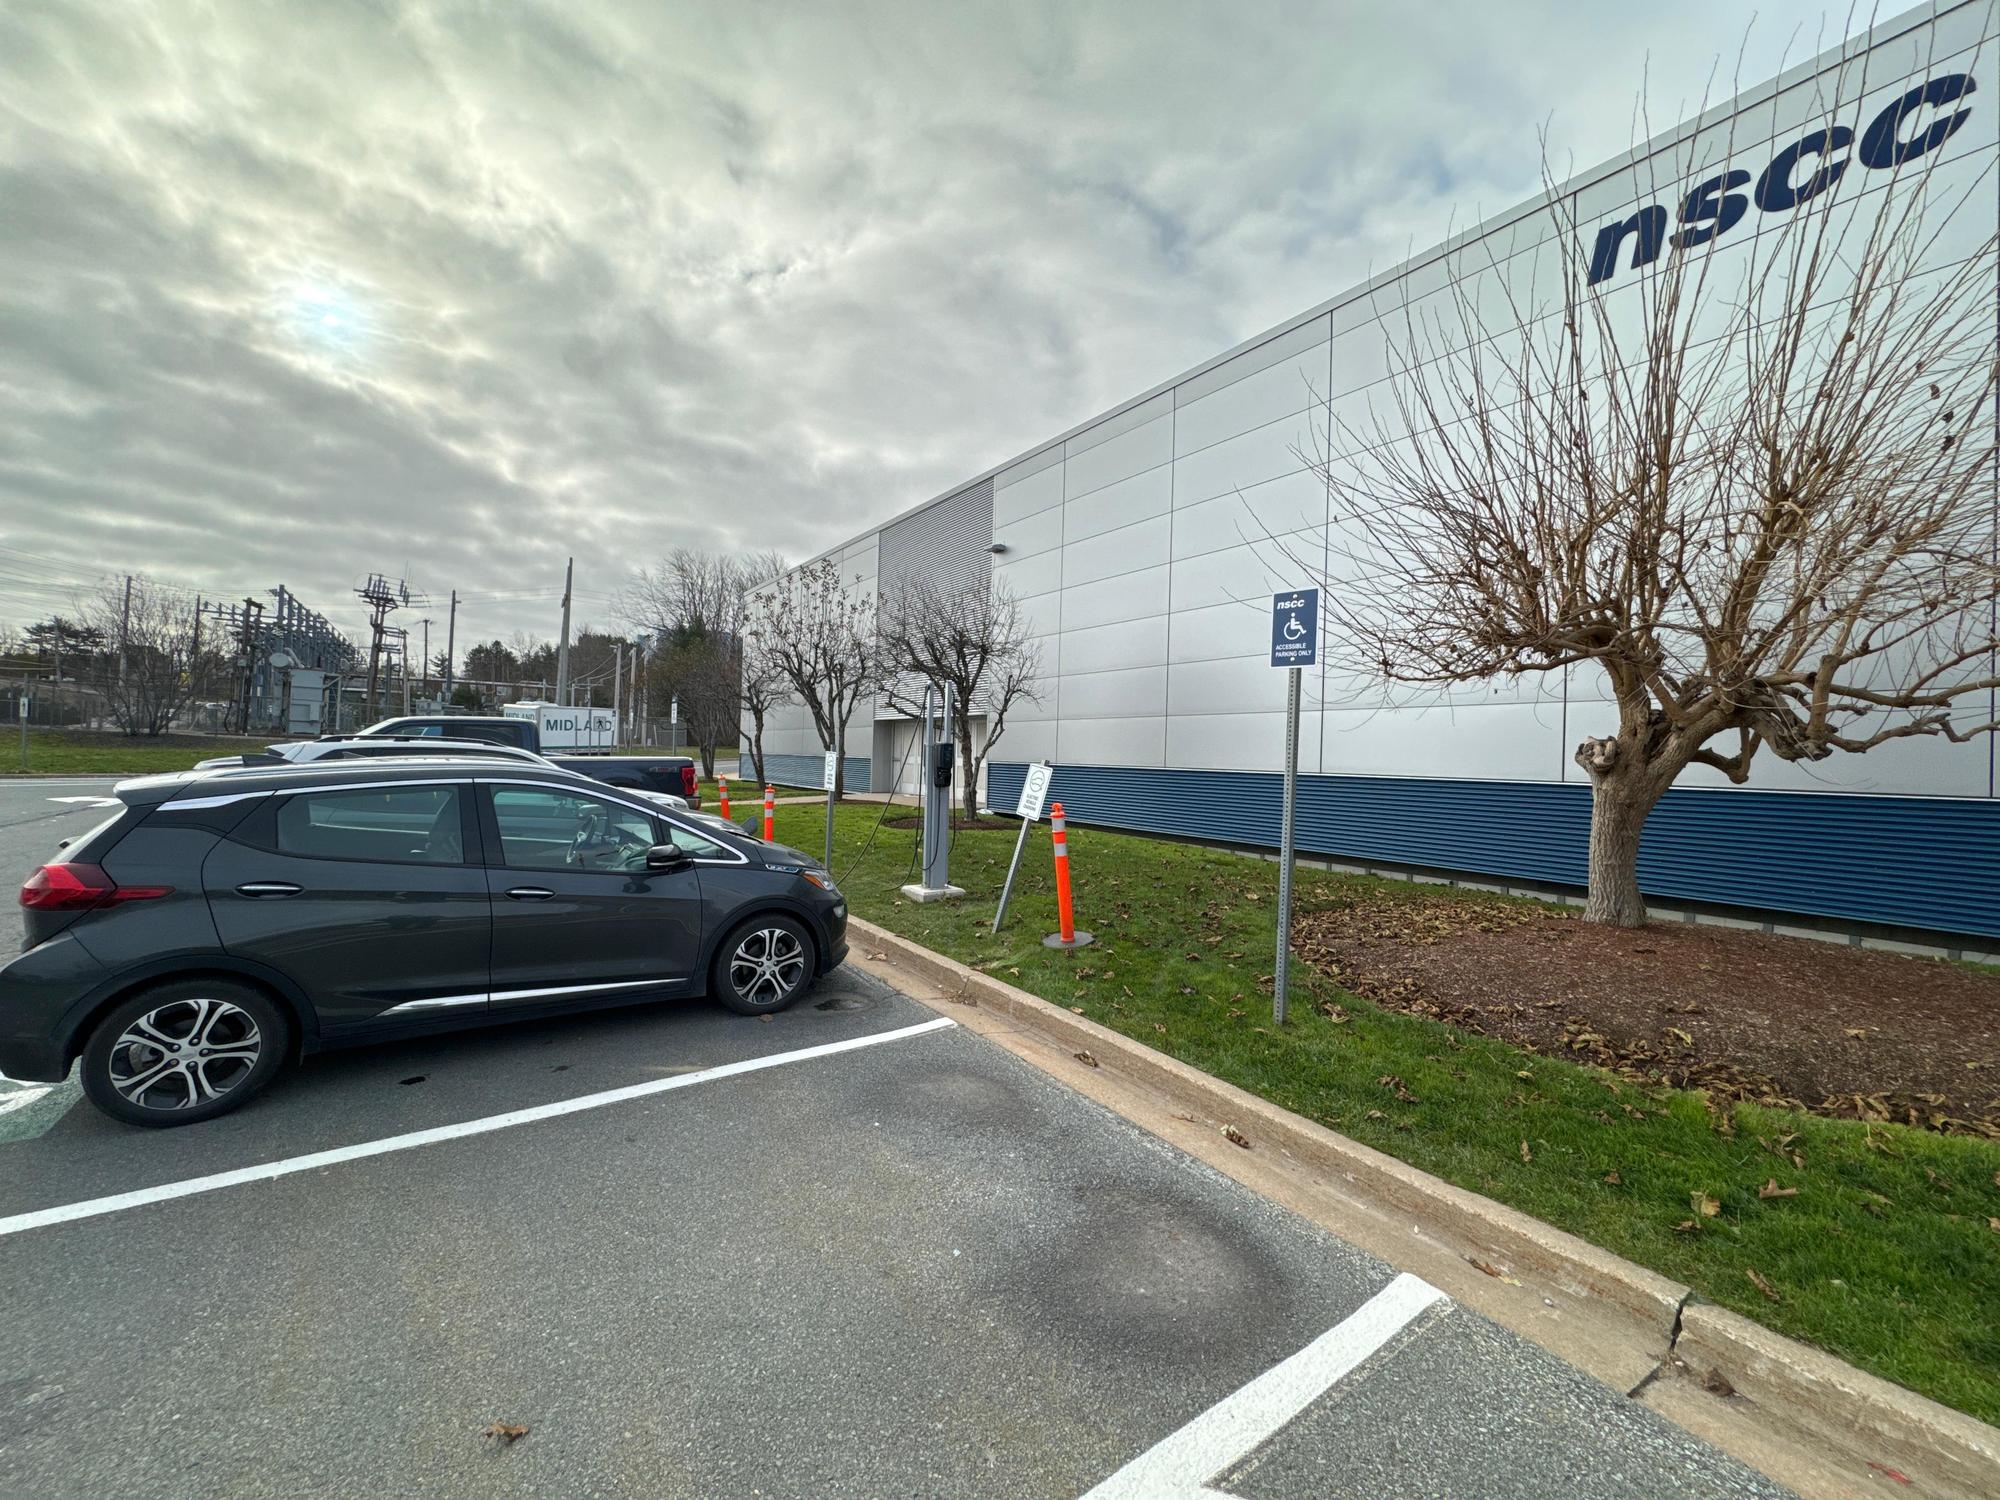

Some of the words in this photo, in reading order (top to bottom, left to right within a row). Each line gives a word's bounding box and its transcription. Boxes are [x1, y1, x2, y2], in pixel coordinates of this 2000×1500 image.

[1587, 74, 1976, 286] nscc
[1277, 600, 1304, 610] nscc
[546, 720, 612, 731] MIDLAD
